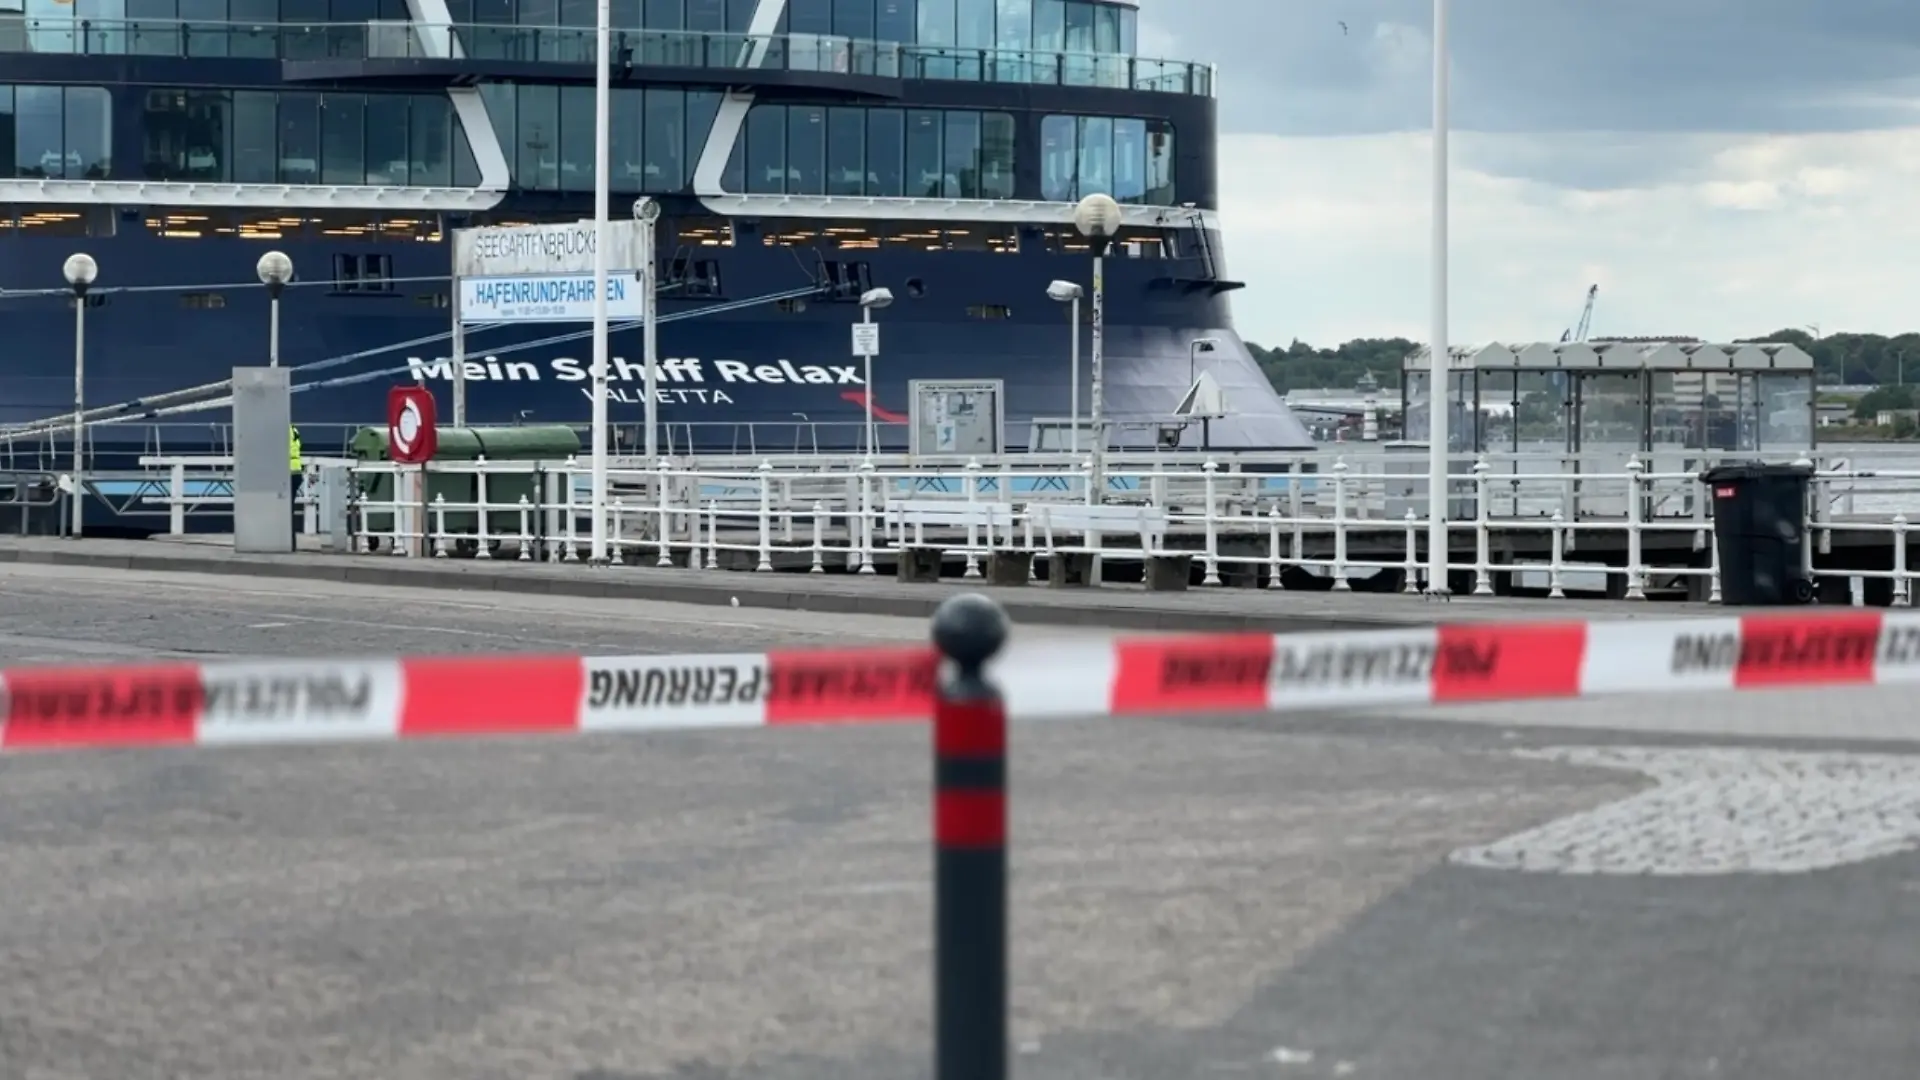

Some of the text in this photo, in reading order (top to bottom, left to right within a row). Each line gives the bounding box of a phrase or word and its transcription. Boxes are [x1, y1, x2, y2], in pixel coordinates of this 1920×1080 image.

[476, 278, 624, 304] HAFENRUNDFAHREN
[407, 356, 540, 381] Mein
[713, 359, 865, 384] Relax
